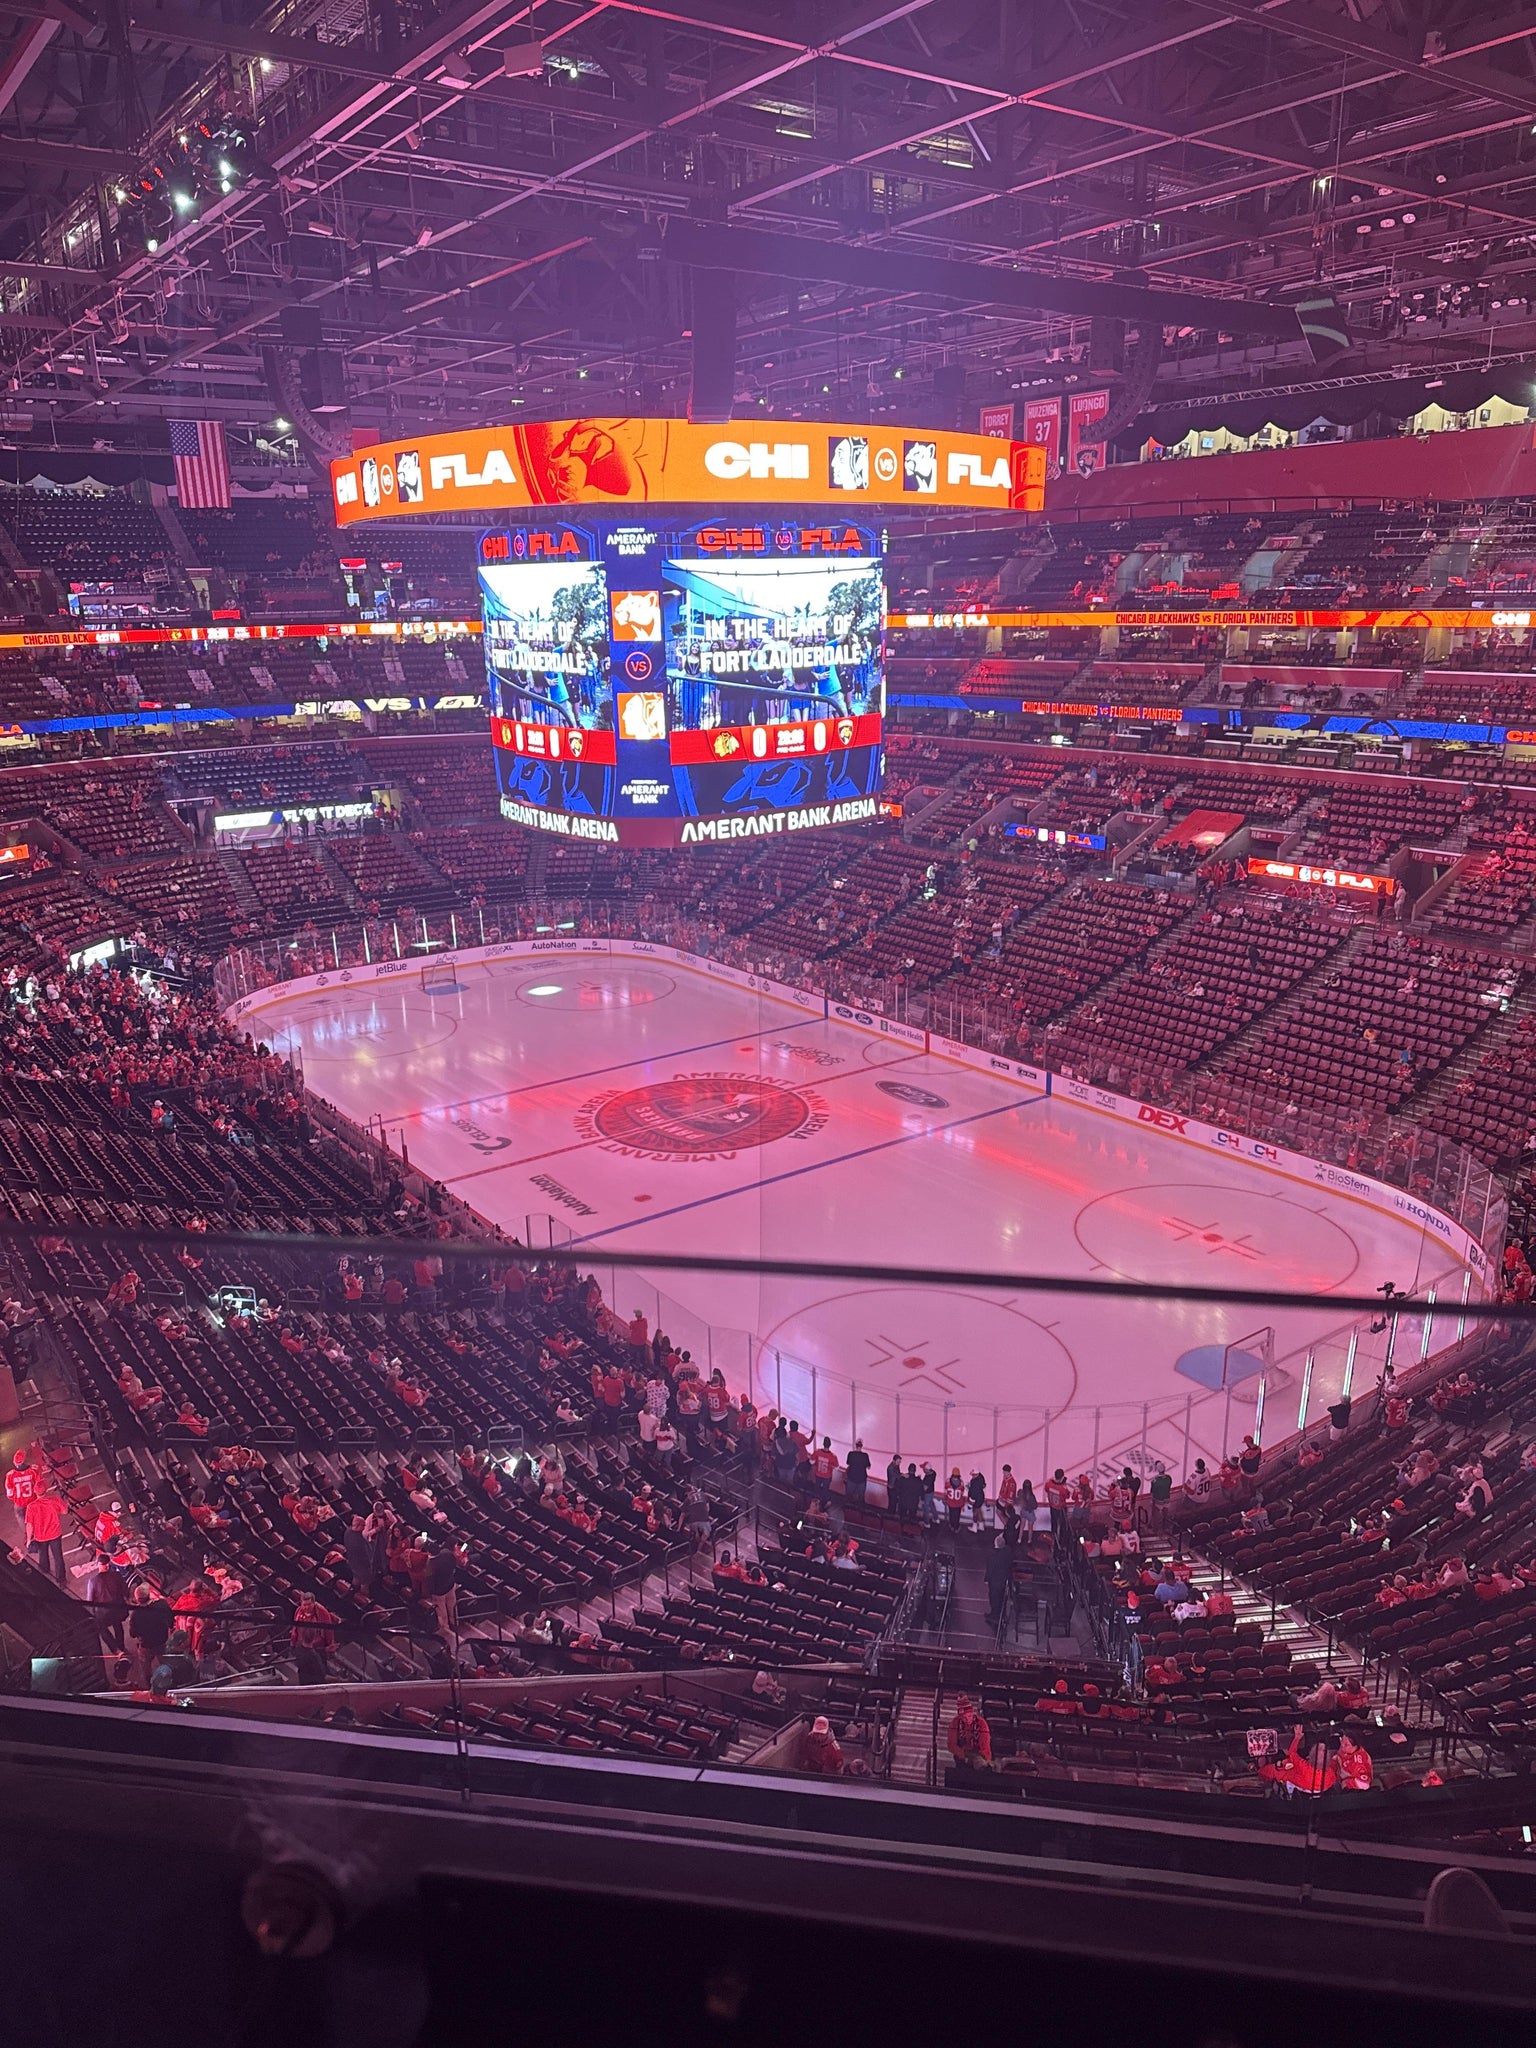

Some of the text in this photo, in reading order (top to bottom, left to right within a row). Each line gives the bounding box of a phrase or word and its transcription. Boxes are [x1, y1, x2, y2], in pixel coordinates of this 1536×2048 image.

[1028, 403, 1058, 418] HUIZENGA
[1073, 396, 1105, 412] LUONGO
[984, 413, 1009, 427] TORREY
[1035, 421, 1051, 442] 37
[705, 441, 809, 479] CHI
[878, 459, 893, 472] VS
[430, 450, 517, 490] FLA
[948, 452, 1012, 489] FLA
[482, 536, 509, 559] CHI
[529, 531, 580, 556] FLA
[696, 527, 863, 551] CHI VS FLA
[618, 545, 646, 555] BANK
[706, 619, 726, 641] IN
[732, 618, 769, 640] THE
[834, 614, 854, 635] OF
[1115, 613, 1147, 625] CHICAGO
[1149, 613, 1200, 625] BLACKHAWKS
[1213, 613, 1247, 625] FLORIDA
[1250, 613, 1294, 625] PANTHERS
[23, 634, 60, 645] CHICAGO
[62, 633, 90, 644] BLACK
[630, 661, 648, 672] VS
[700, 643, 863, 673] FORT LAUDERDALE
[364, 698, 412, 712] VS
[1022, 701, 1051, 714] CHICAGO
[1052, 702, 1098, 717] BLACKHAWKS
[1110, 706, 1140, 720] FLORIDA
[1142, 707, 1183, 722] PANTHERS
[753, 727, 767, 758] 0
[814, 721, 827, 752] 0
[621, 784, 670, 795] AMERANT
[632, 795, 659, 804] BANK
[540, 809, 570, 835] BANK
[571, 817, 619, 843] ARENA
[681, 811, 786, 843] AMERANT
[788, 806, 831, 831] BANK
[832, 798, 876, 824] ARENA
[1067, 833, 1092, 846] FLA
[1339, 874, 1374, 890] FLA
[531, 940, 577, 950] AutoNation
[375, 962, 407, 977] jetBlue
[889, 1024, 924, 1042] Baptist Health
[673, 1071, 832, 1141] AMERANT BANK ARENA
[573, 1088, 738, 1164] AMERANT BANK ARENA
[634, 1105, 706, 1141] PANTHERS
[1137, 1105, 1190, 1135] DEX
[452, 1118, 491, 1142] CELSIUS
[1217, 1132, 1240, 1148] CH
[1254, 1144, 1277, 1161] CH
[1327, 1169, 1371, 1193] BioStem
[529, 1174, 599, 1217] AutoNation
[1407, 1202, 1452, 1237] HONDA
[15, 1482, 33, 1498] 13
[947, 1488, 961, 1501] 30
[1197, 1481, 1210, 1496] 30
